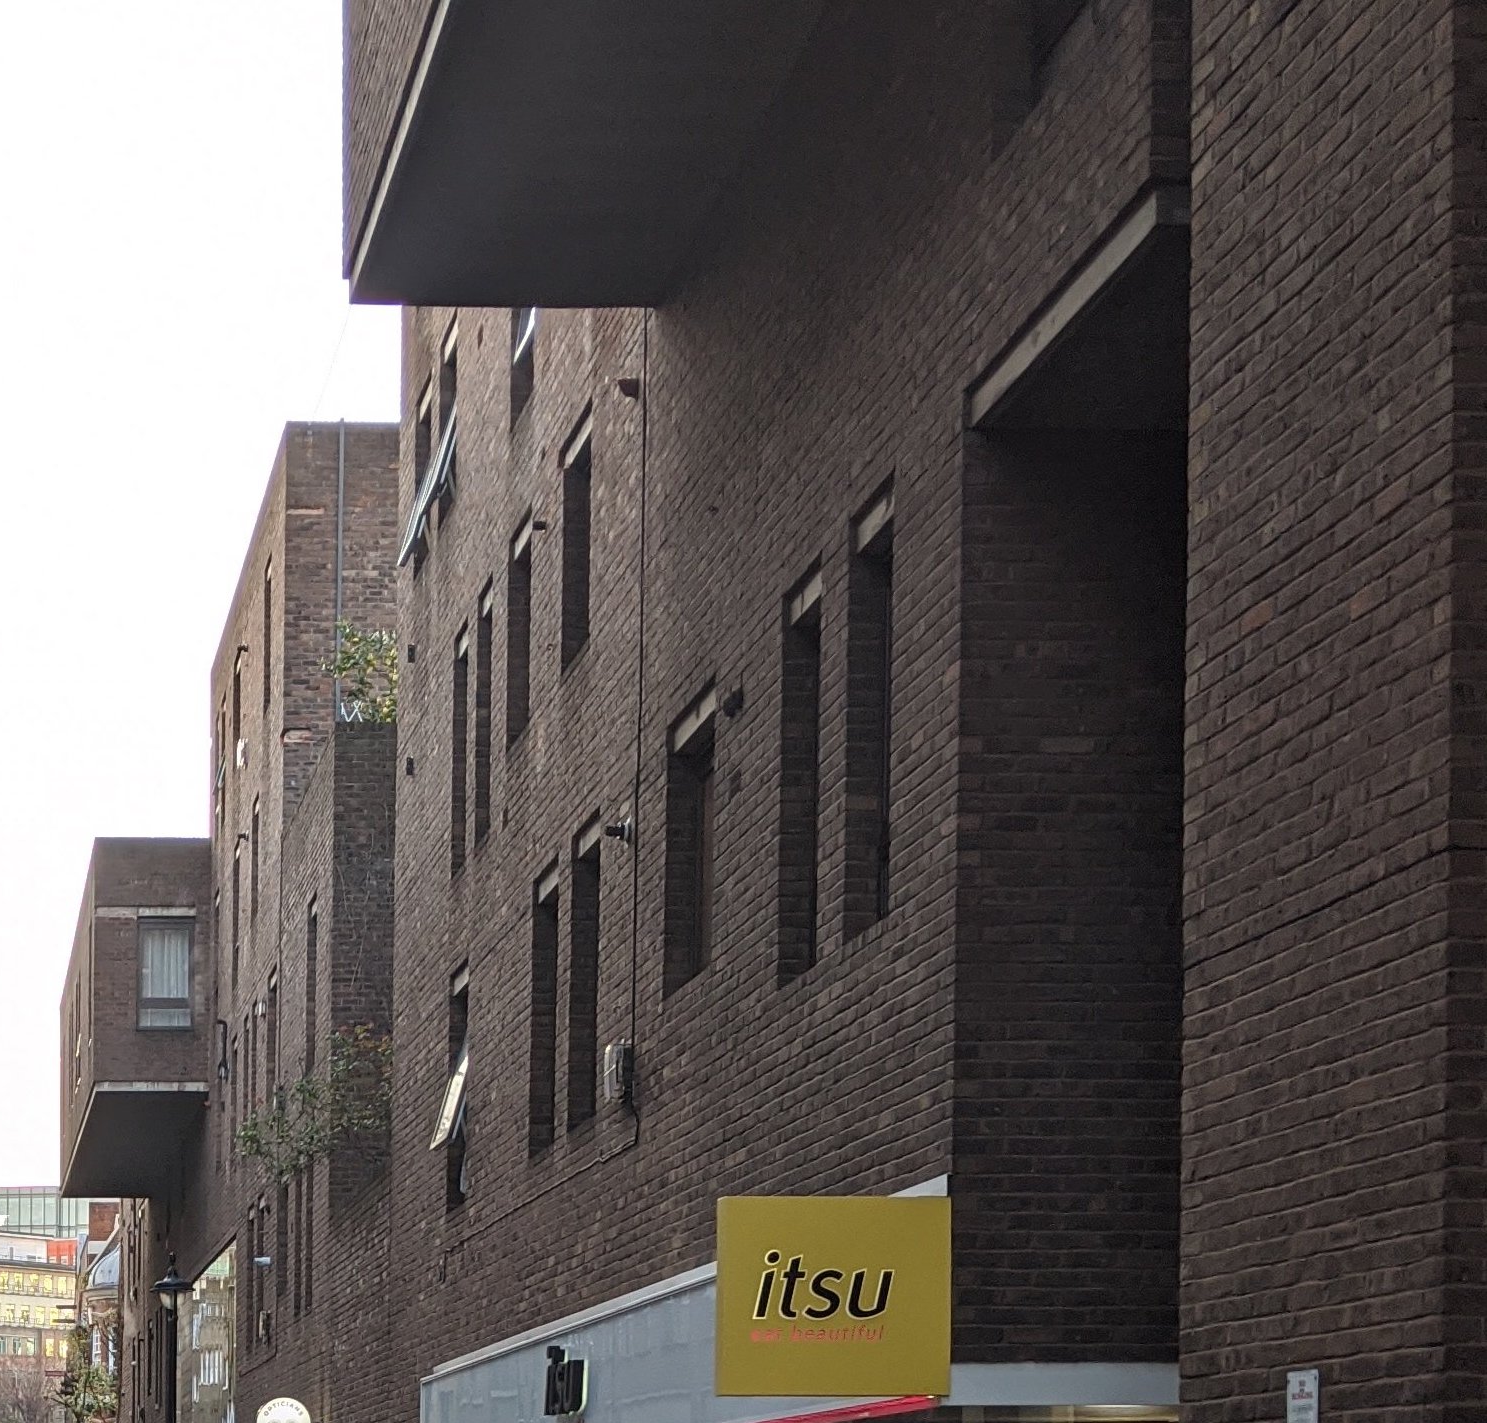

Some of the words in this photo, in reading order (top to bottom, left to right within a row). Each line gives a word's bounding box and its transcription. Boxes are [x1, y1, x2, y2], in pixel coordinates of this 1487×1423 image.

[752, 1249, 895, 1321] itsu
[750, 1327, 784, 1343] eat
[789, 1324, 884, 1344] beautiful
[263, 1401, 304, 1416] OPTICIANS
